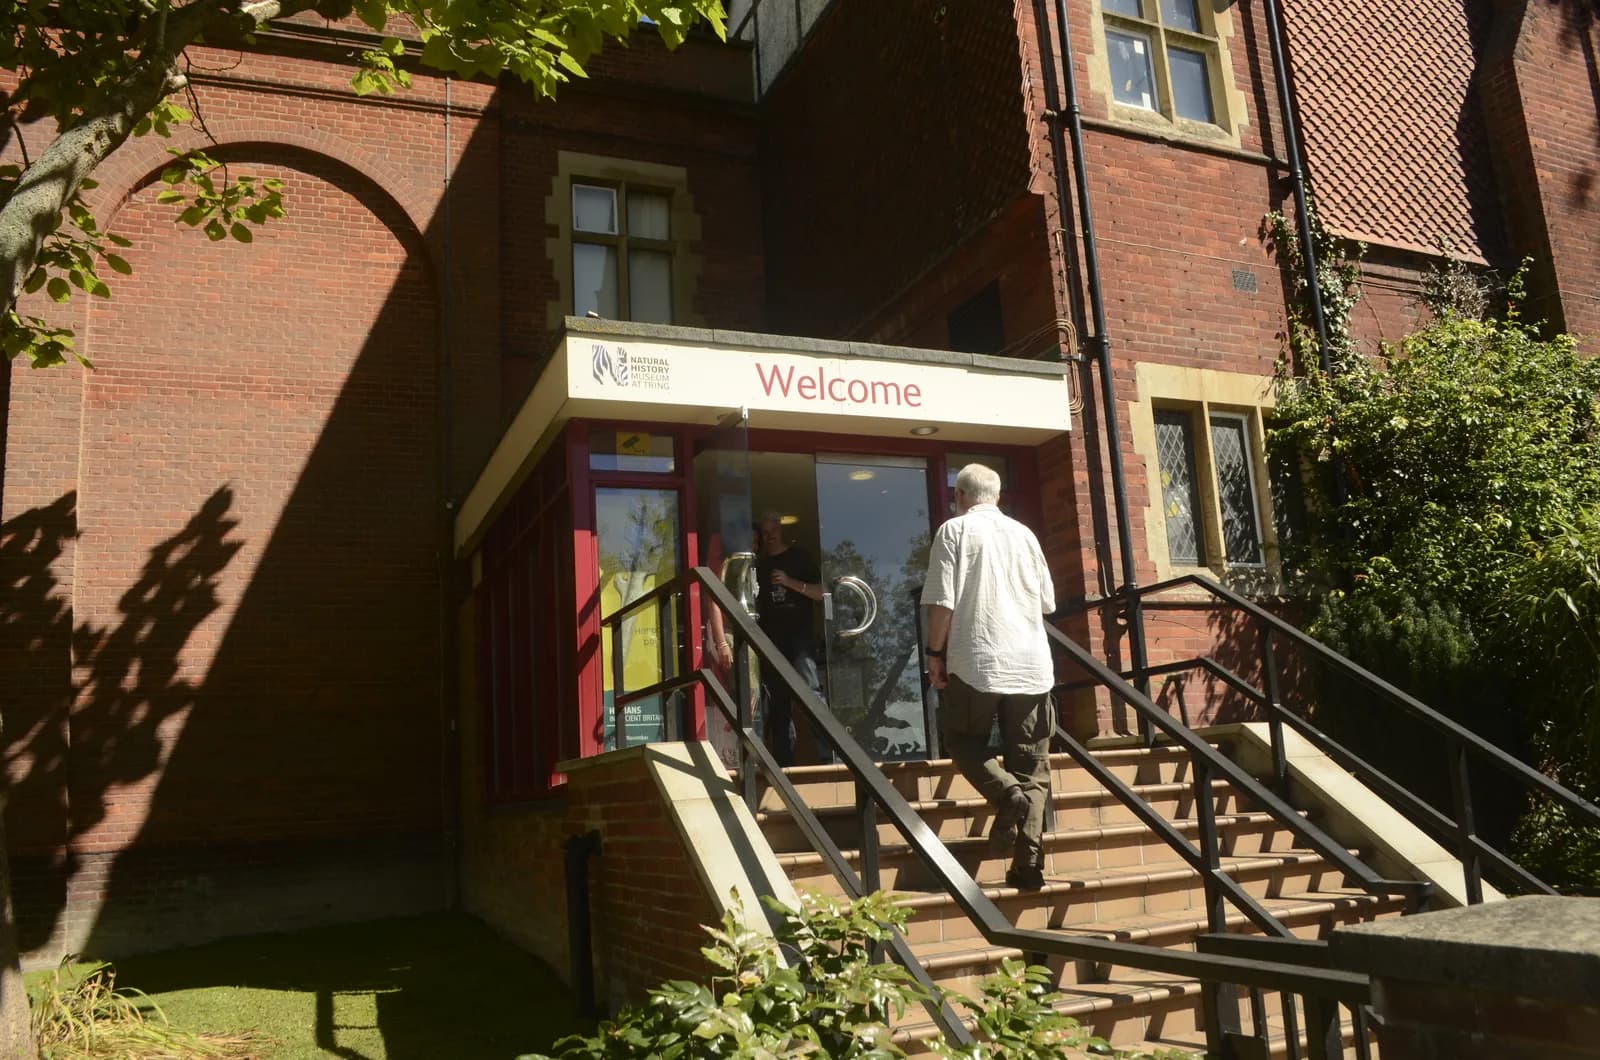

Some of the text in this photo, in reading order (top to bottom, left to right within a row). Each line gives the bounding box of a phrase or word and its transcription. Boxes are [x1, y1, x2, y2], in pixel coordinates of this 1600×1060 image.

[630, 356, 670, 366] NATURAL
[630, 365, 670, 374] HISTORY
[631, 373, 670, 382] MUSEUM
[755, 363, 922, 407] Welcome
[609, 706, 642, 715] HANS
